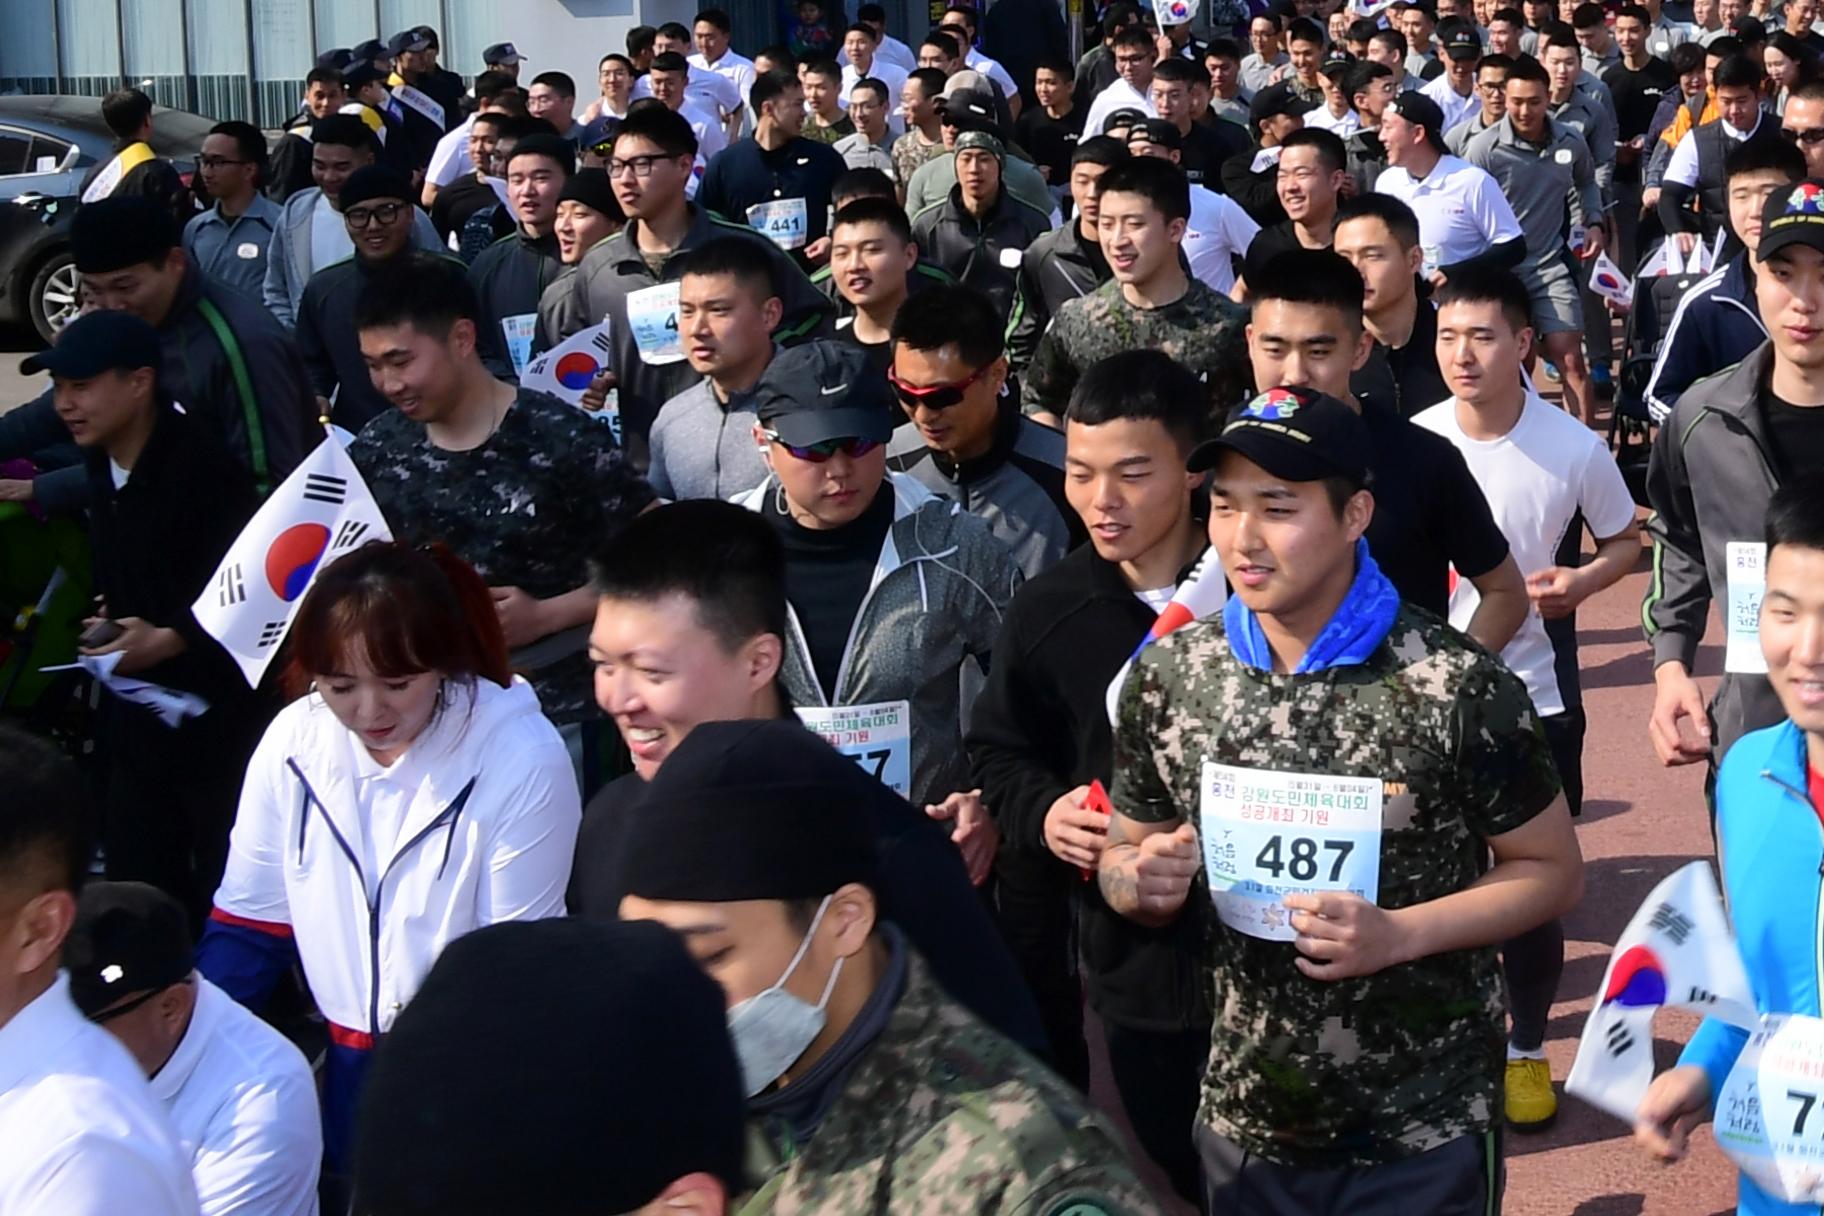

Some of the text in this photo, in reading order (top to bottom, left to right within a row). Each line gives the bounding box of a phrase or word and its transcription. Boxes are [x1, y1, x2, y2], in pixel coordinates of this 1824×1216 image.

[771, 217, 799, 232] 441
[1241, 786, 1369, 810] 강원도민체육대회
[1240, 804, 1329, 826] 성공개최 기원
[1255, 835, 1355, 882] 487
